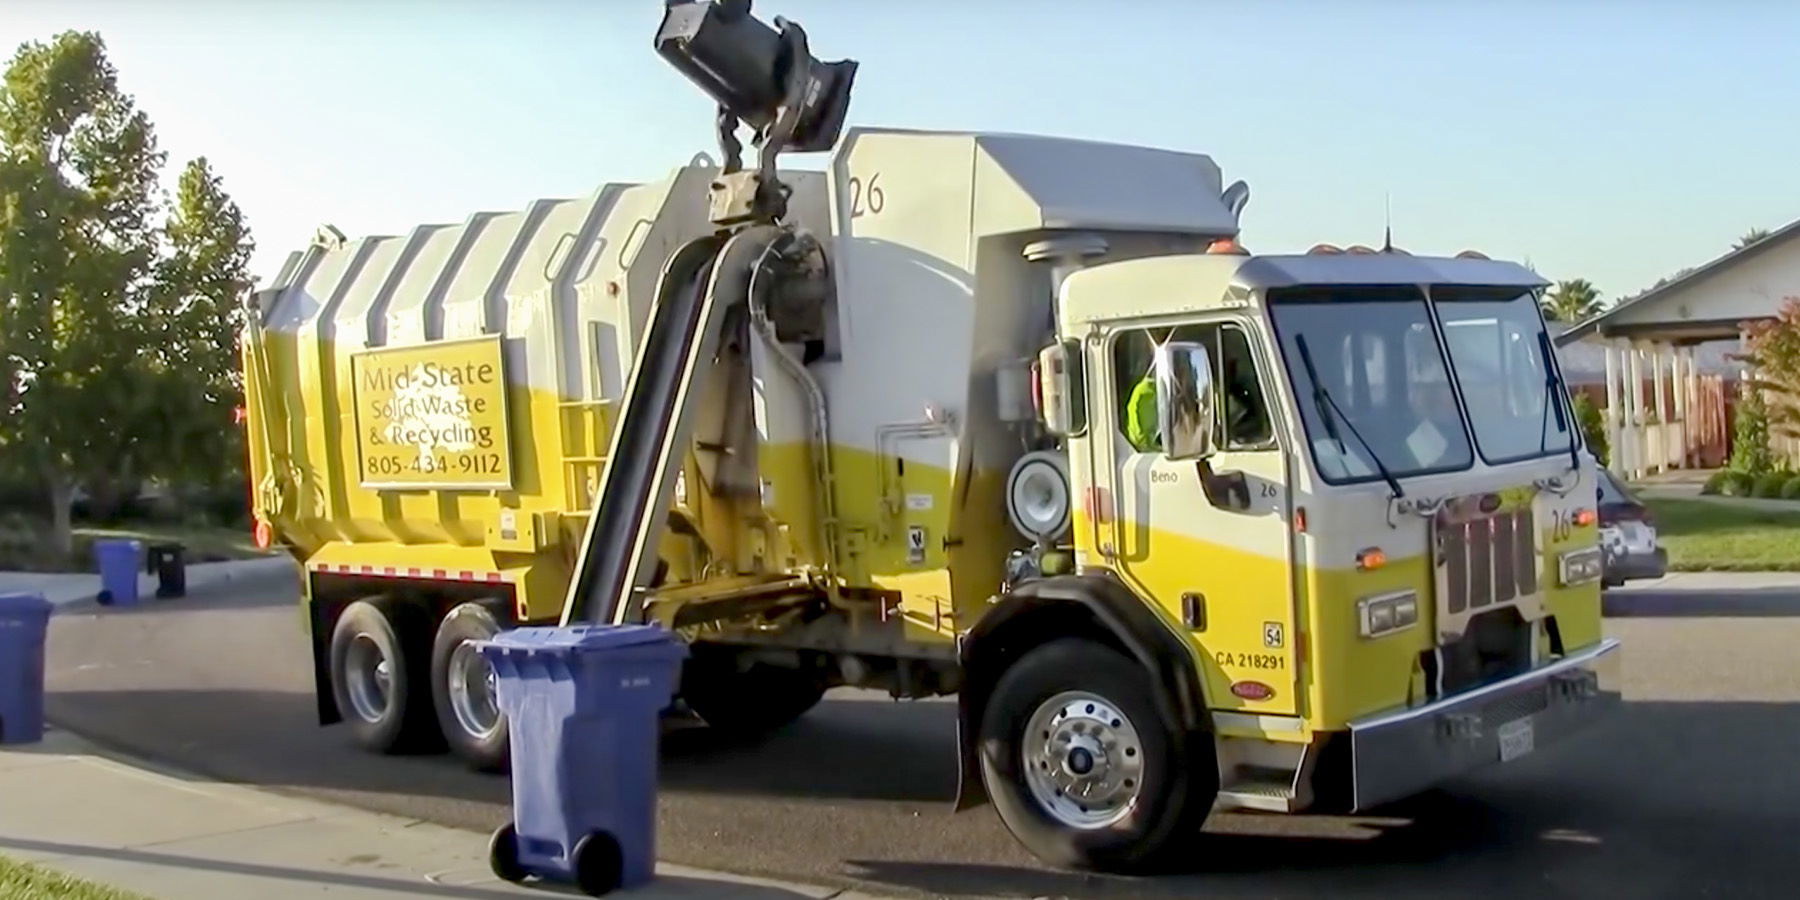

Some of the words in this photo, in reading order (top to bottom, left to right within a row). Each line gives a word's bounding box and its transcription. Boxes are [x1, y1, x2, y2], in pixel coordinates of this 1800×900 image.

[850, 172, 884, 219] 26
[363, 362, 493, 390] Mid-State
[371, 398, 416, 419] Solid
[422, 396, 486, 415] Waste
[370, 427, 384, 445] &
[393, 423, 493, 449] Recycling
[368, 454, 501, 474] 805-434-9112
[1151, 470, 1178, 483] Beno
[1261, 483, 1277, 497] 26
[1552, 509, 1570, 543] 26
[1216, 651, 1235, 667] CA
[1238, 653, 1285, 669] 218291
